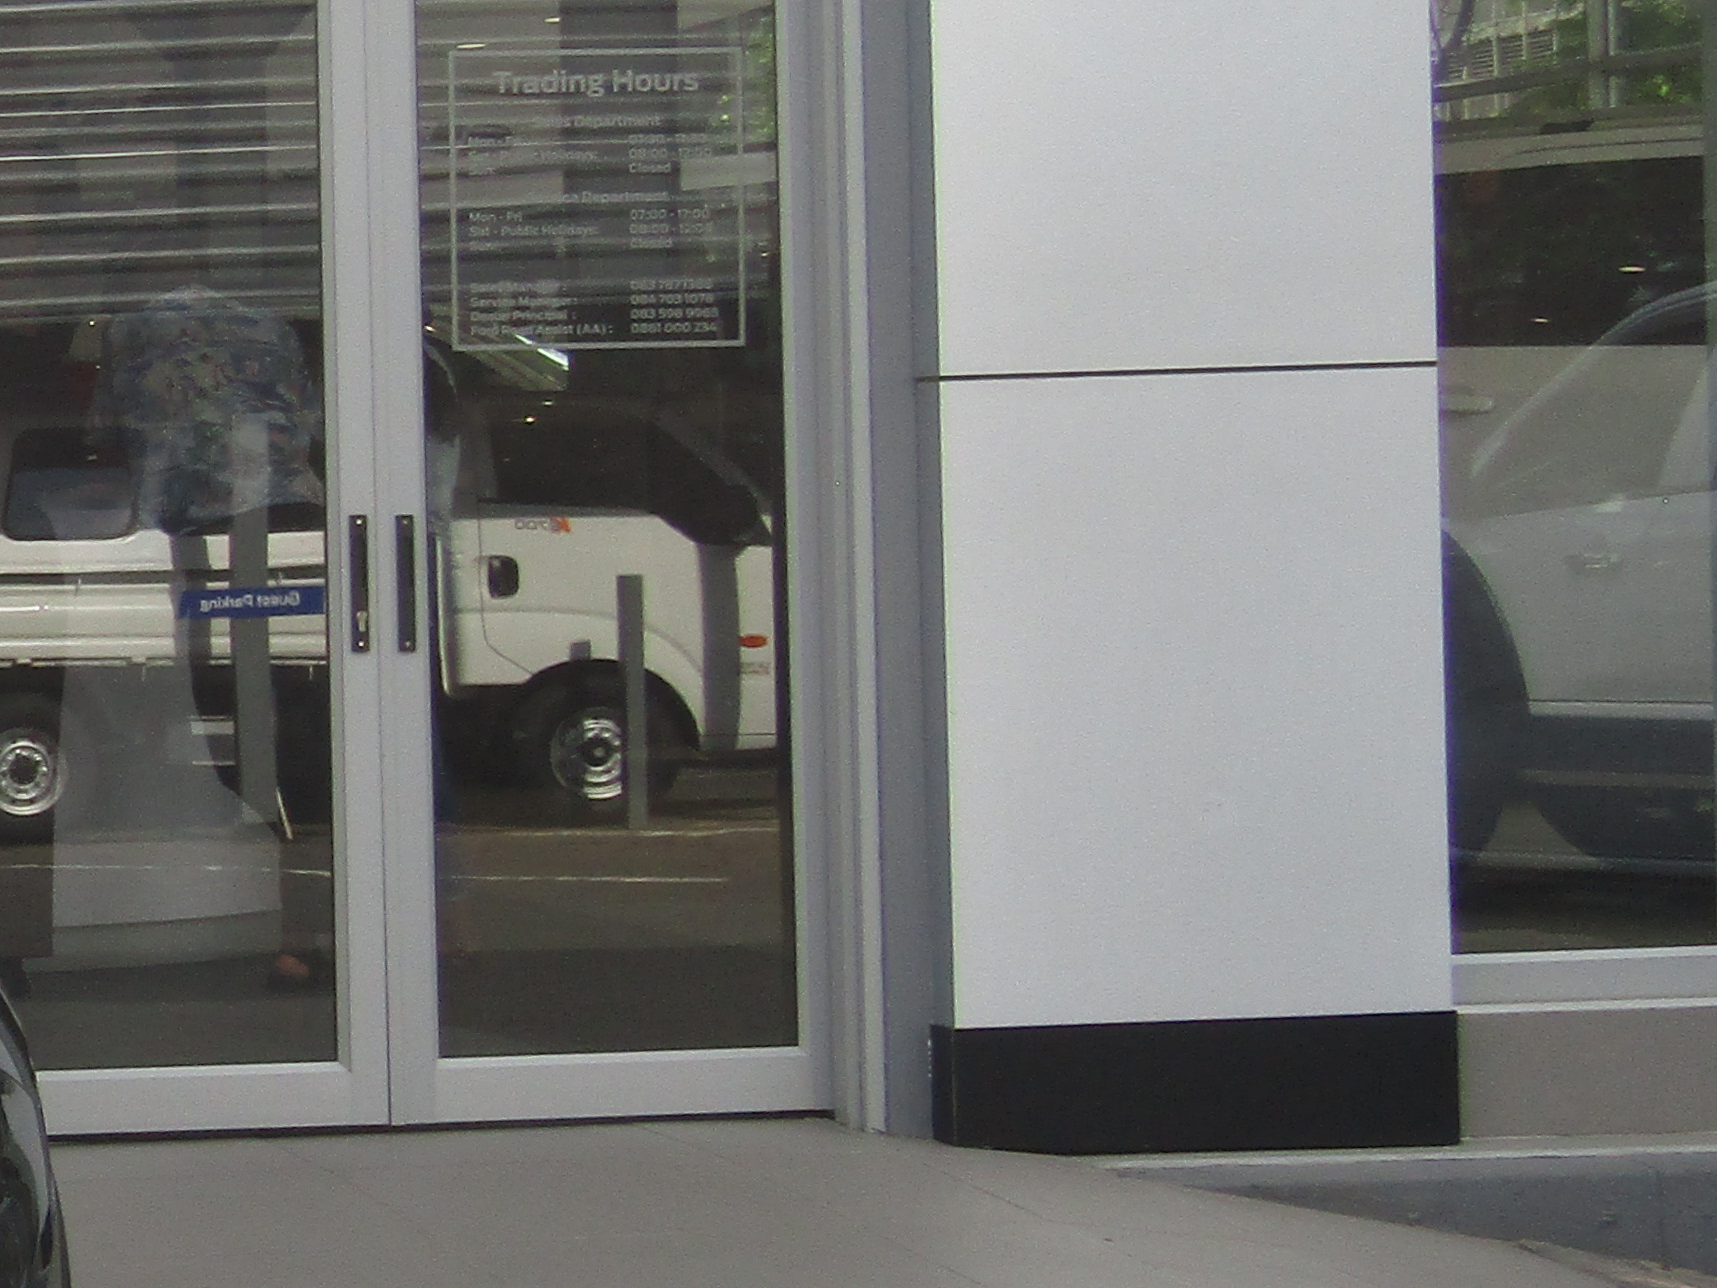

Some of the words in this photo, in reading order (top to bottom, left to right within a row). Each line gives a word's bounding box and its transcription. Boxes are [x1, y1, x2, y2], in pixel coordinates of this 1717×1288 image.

[493, 69, 605, 97] Trading
[612, 69, 699, 93] Hours
[629, 162, 671, 173] Closed
